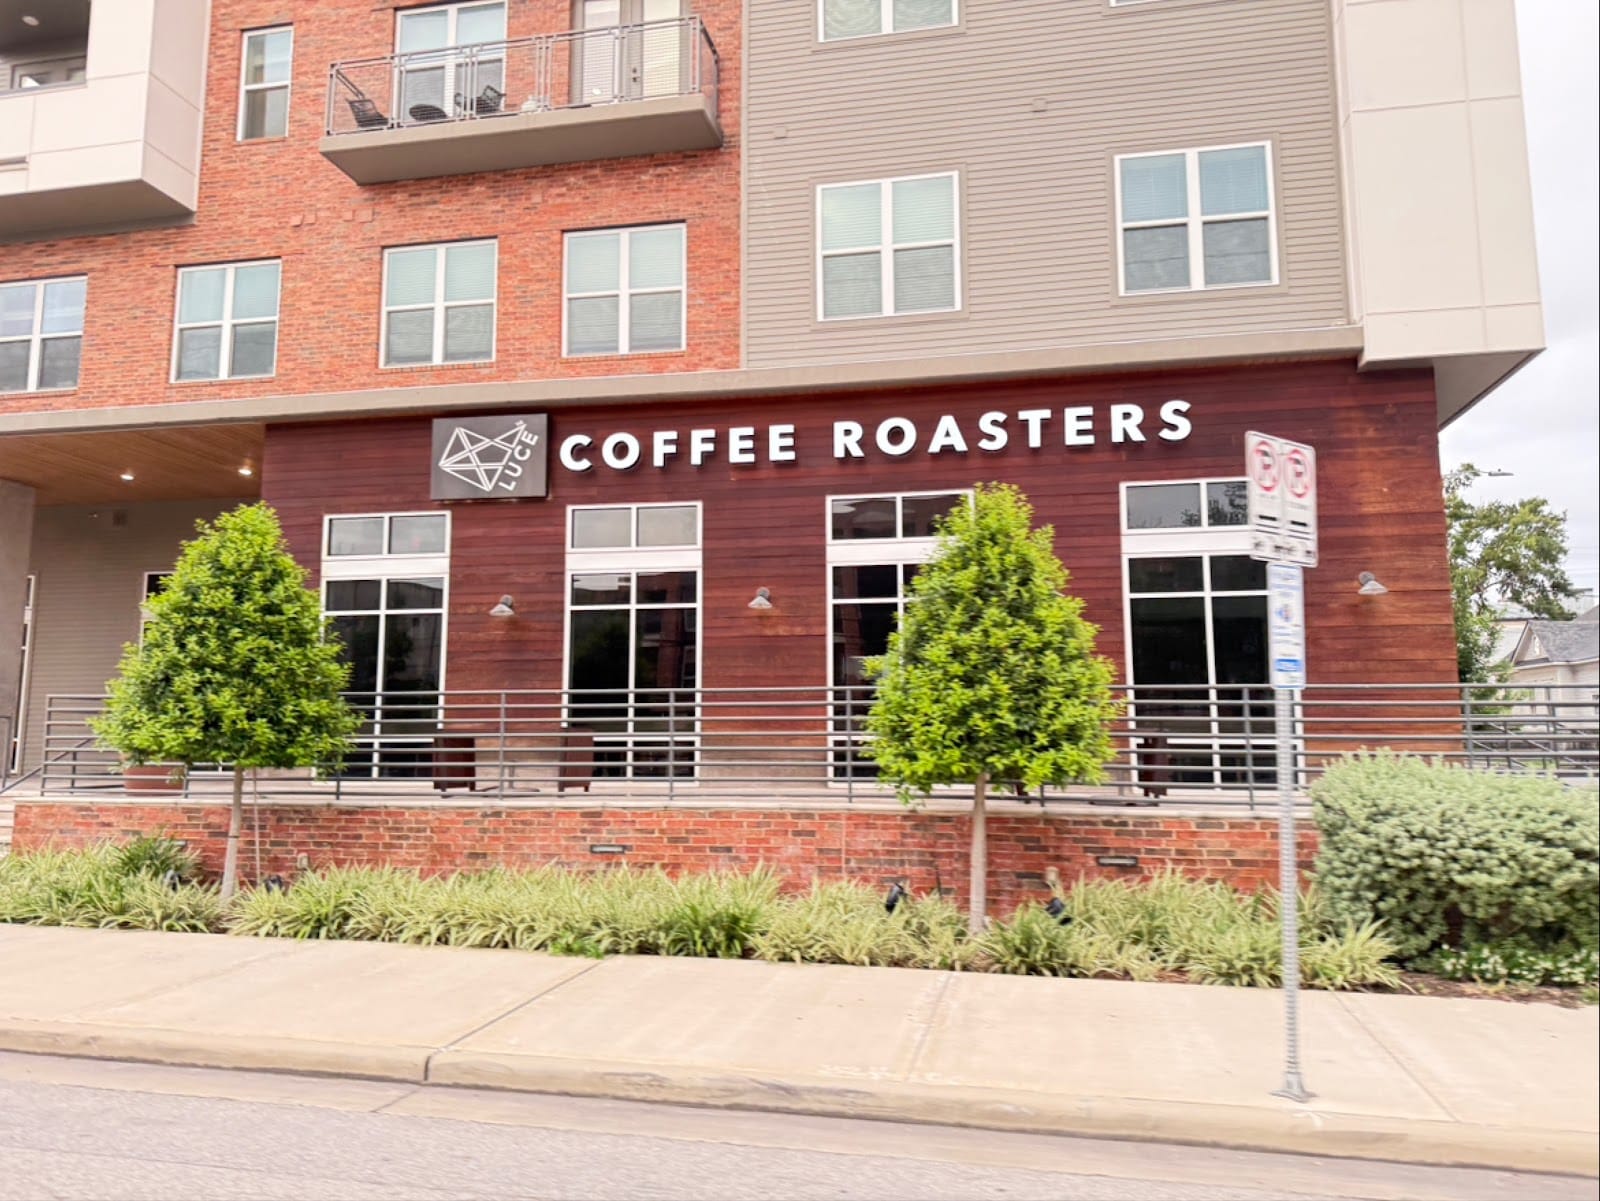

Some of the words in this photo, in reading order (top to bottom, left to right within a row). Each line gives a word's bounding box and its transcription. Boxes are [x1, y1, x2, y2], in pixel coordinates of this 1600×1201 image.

[498, 430, 539, 491] LUCE
[559, 424, 796, 472] COFFEE
[833, 400, 1193, 458] ROASTERS
